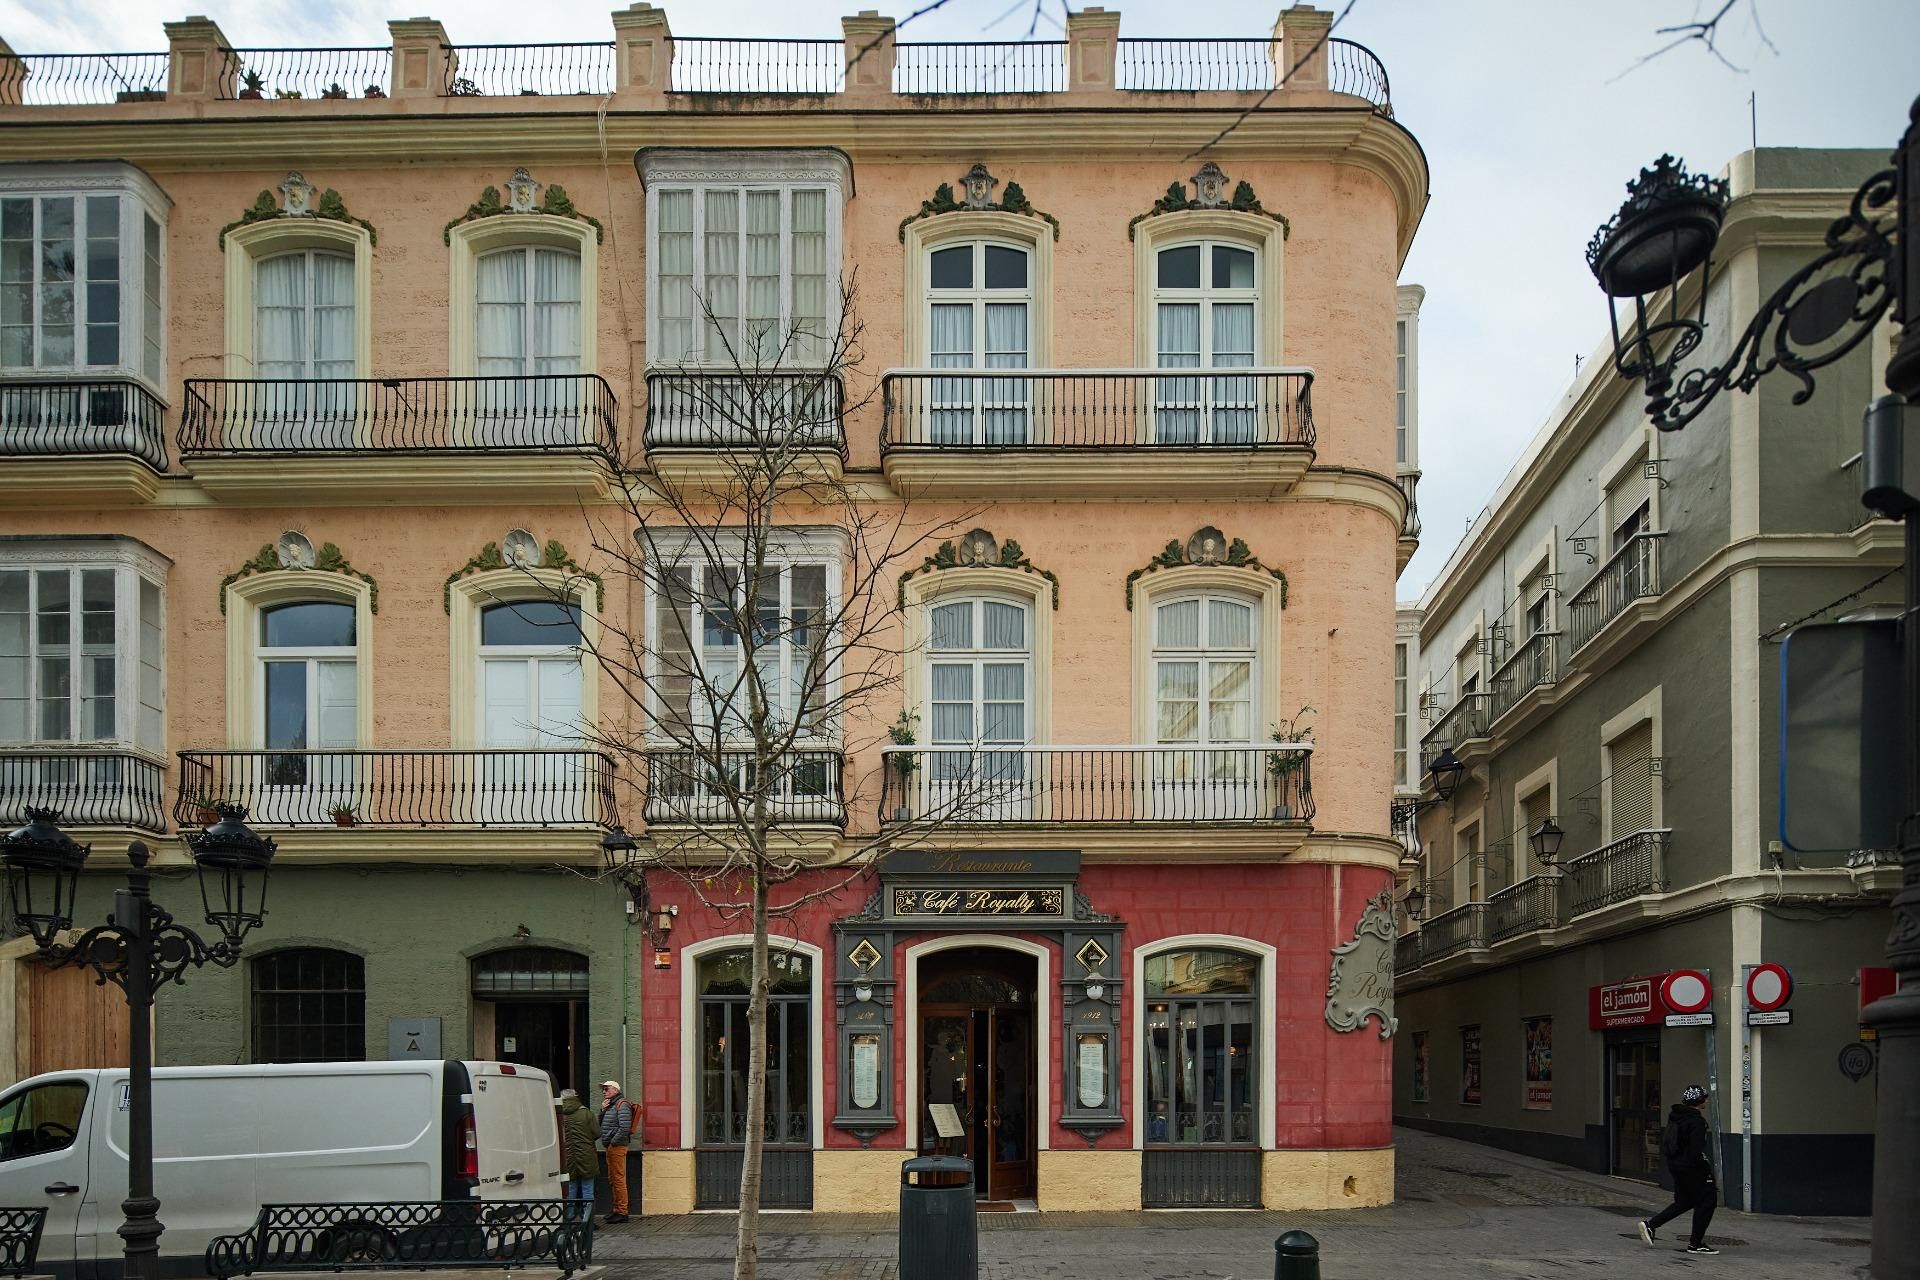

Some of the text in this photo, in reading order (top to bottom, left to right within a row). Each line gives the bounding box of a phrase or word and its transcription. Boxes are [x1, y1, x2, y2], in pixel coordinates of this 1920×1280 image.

[931, 853, 1032, 872] Restaurante
[922, 890, 1035, 914] Café Royalty
[1604, 986, 1648, 1009] el jamón
[1606, 1016, 1645, 1026] SUPERMERCADO
